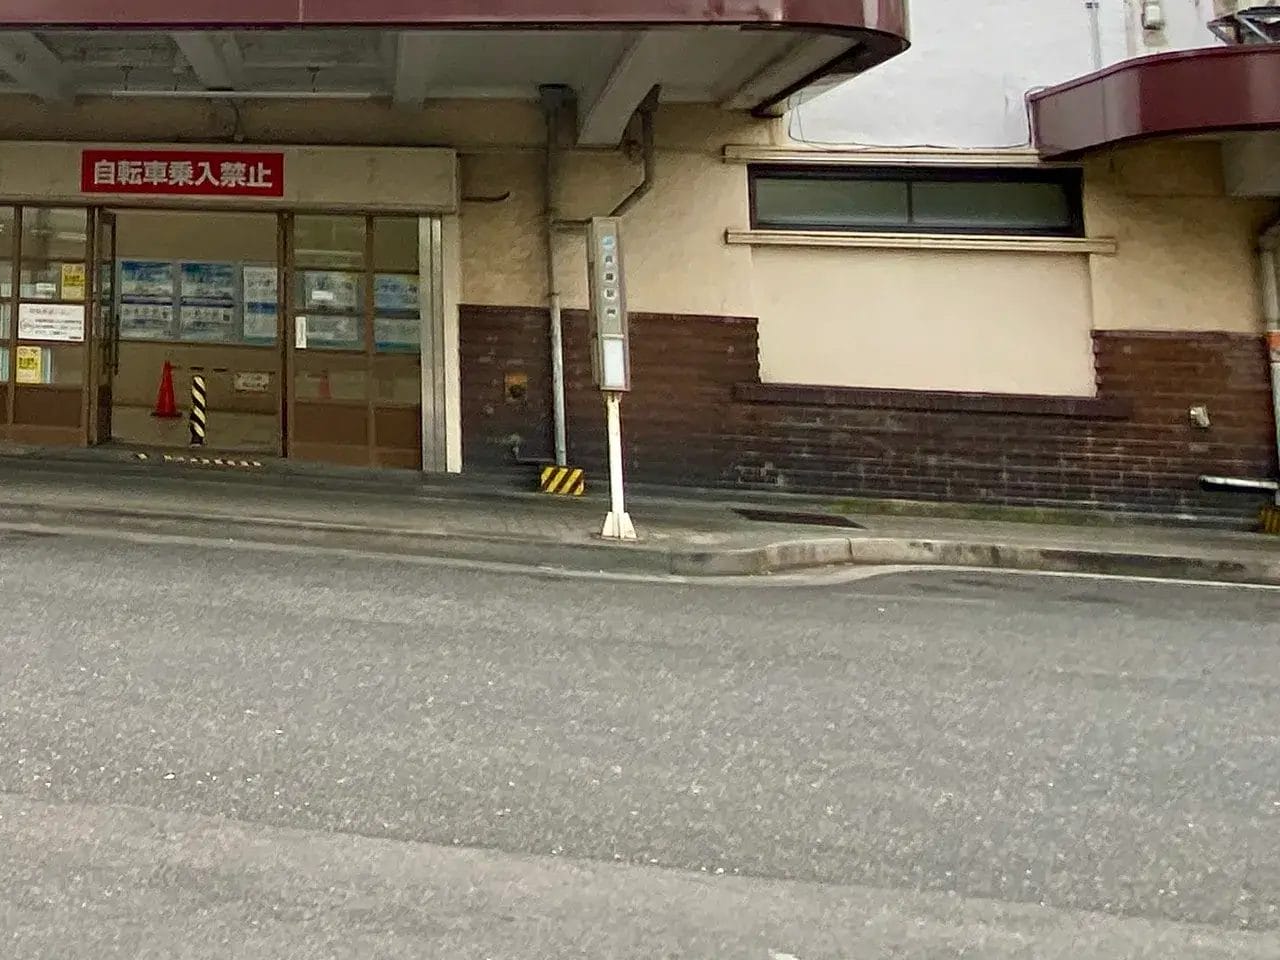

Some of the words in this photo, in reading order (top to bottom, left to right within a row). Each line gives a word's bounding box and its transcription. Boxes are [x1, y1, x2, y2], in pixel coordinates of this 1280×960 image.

[94, 159, 273, 188] 自転車乗入禁止
